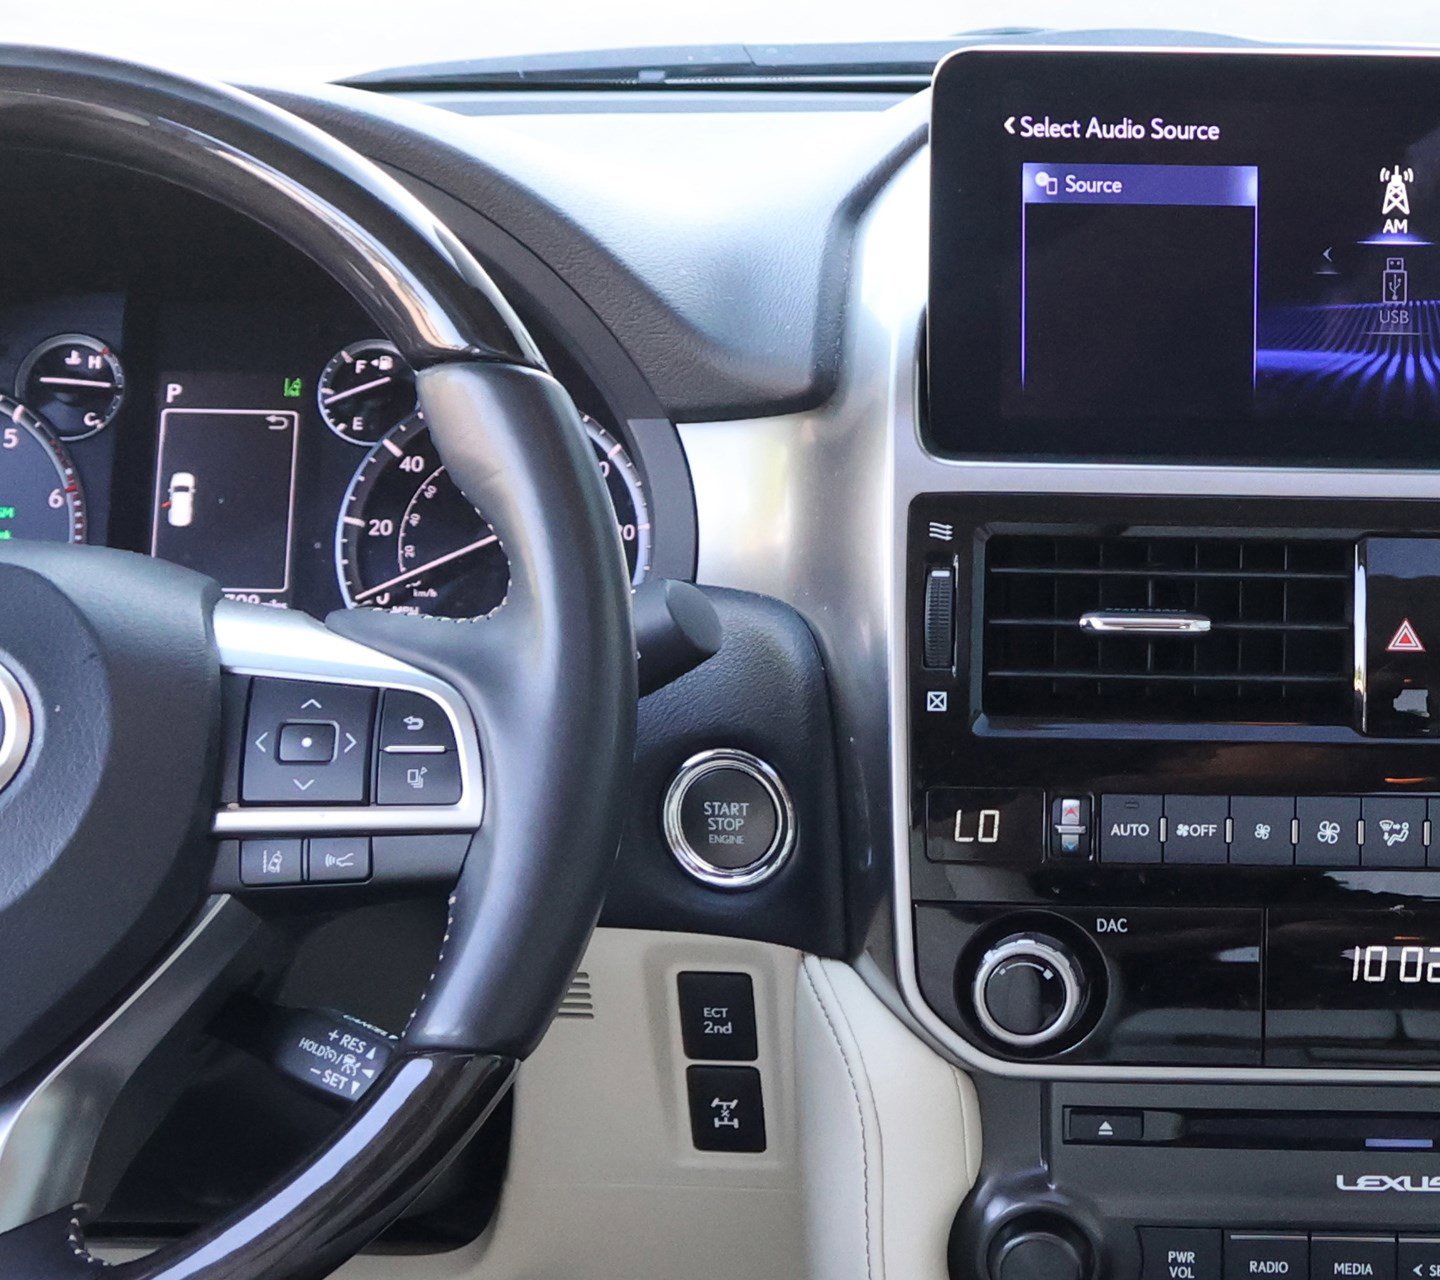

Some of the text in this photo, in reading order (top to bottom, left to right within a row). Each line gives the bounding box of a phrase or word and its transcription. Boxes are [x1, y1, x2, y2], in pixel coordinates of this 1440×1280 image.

[1019, 116, 1221, 141] Select Audio Source
[1064, 175, 1123, 195] Source
[1382, 218, 1409, 234] AM
[1379, 309, 1410, 326] USB
[88, 356, 102, 370] H
[355, 359, 367, 373] F
[166, 383, 183, 403] P
[83, 412, 99, 427] C
[352, 416, 364, 430] E
[3, 428, 19, 449] 5
[400, 456, 425, 473] 40
[48, 488, 64, 509] 6
[369, 518, 393, 537] 20
[703, 802, 750, 817] START
[707, 817, 744, 832] STOP
[954, 809, 1000, 842] LO
[1110, 823, 1150, 837] AUTO
[1189, 824, 1218, 838] OFF
[708, 833, 745, 845] ENGINE
[1096, 918, 1128, 933] DAC
[702, 1007, 729, 1019] ECT
[702, 1021, 732, 1035] 2nd
[339, 1033, 367, 1054] RES
[322, 1068, 349, 1090] SET
[1167, 1251, 1197, 1264] PWR
[1168, 1265, 1196, 1279] VOL
[1248, 1259, 1290, 1276] RADIO
[1333, 1261, 1375, 1277] MEDIA
